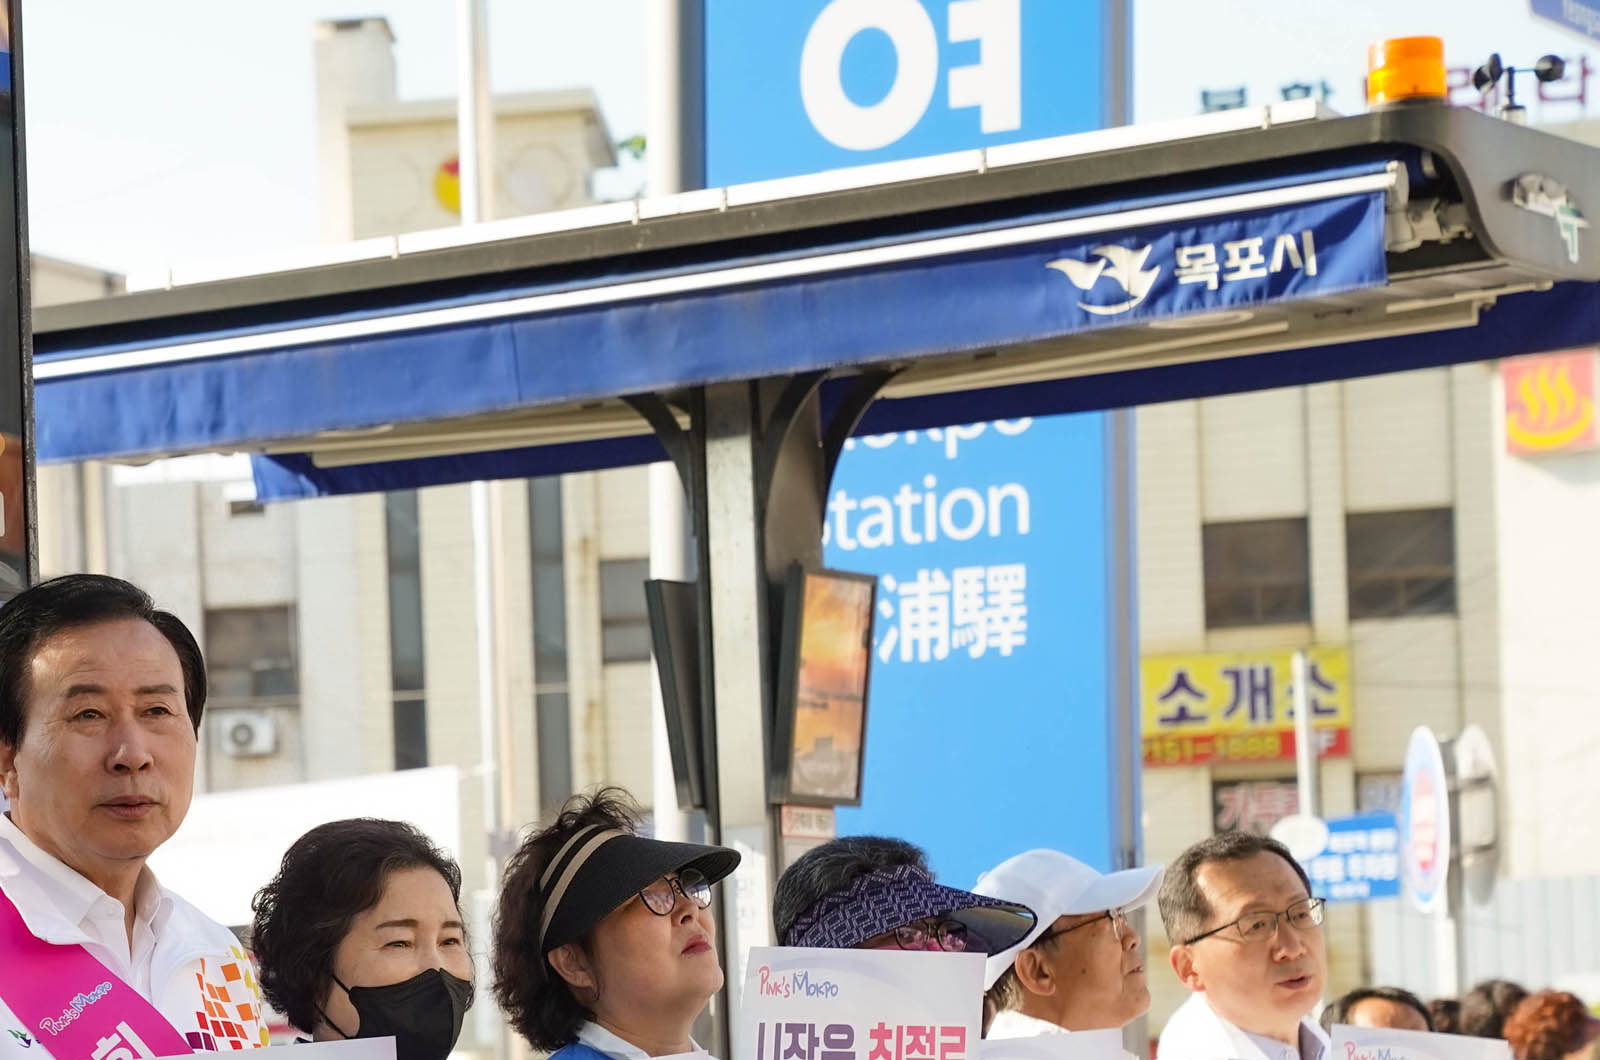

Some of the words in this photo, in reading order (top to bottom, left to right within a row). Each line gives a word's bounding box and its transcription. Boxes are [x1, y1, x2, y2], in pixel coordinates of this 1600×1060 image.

[1175, 229, 1318, 291] 목포시
[823, 474, 1031, 551] tation
[876, 563, 1029, 664] 浦驛
[1158, 663, 1338, 727] 소개소
